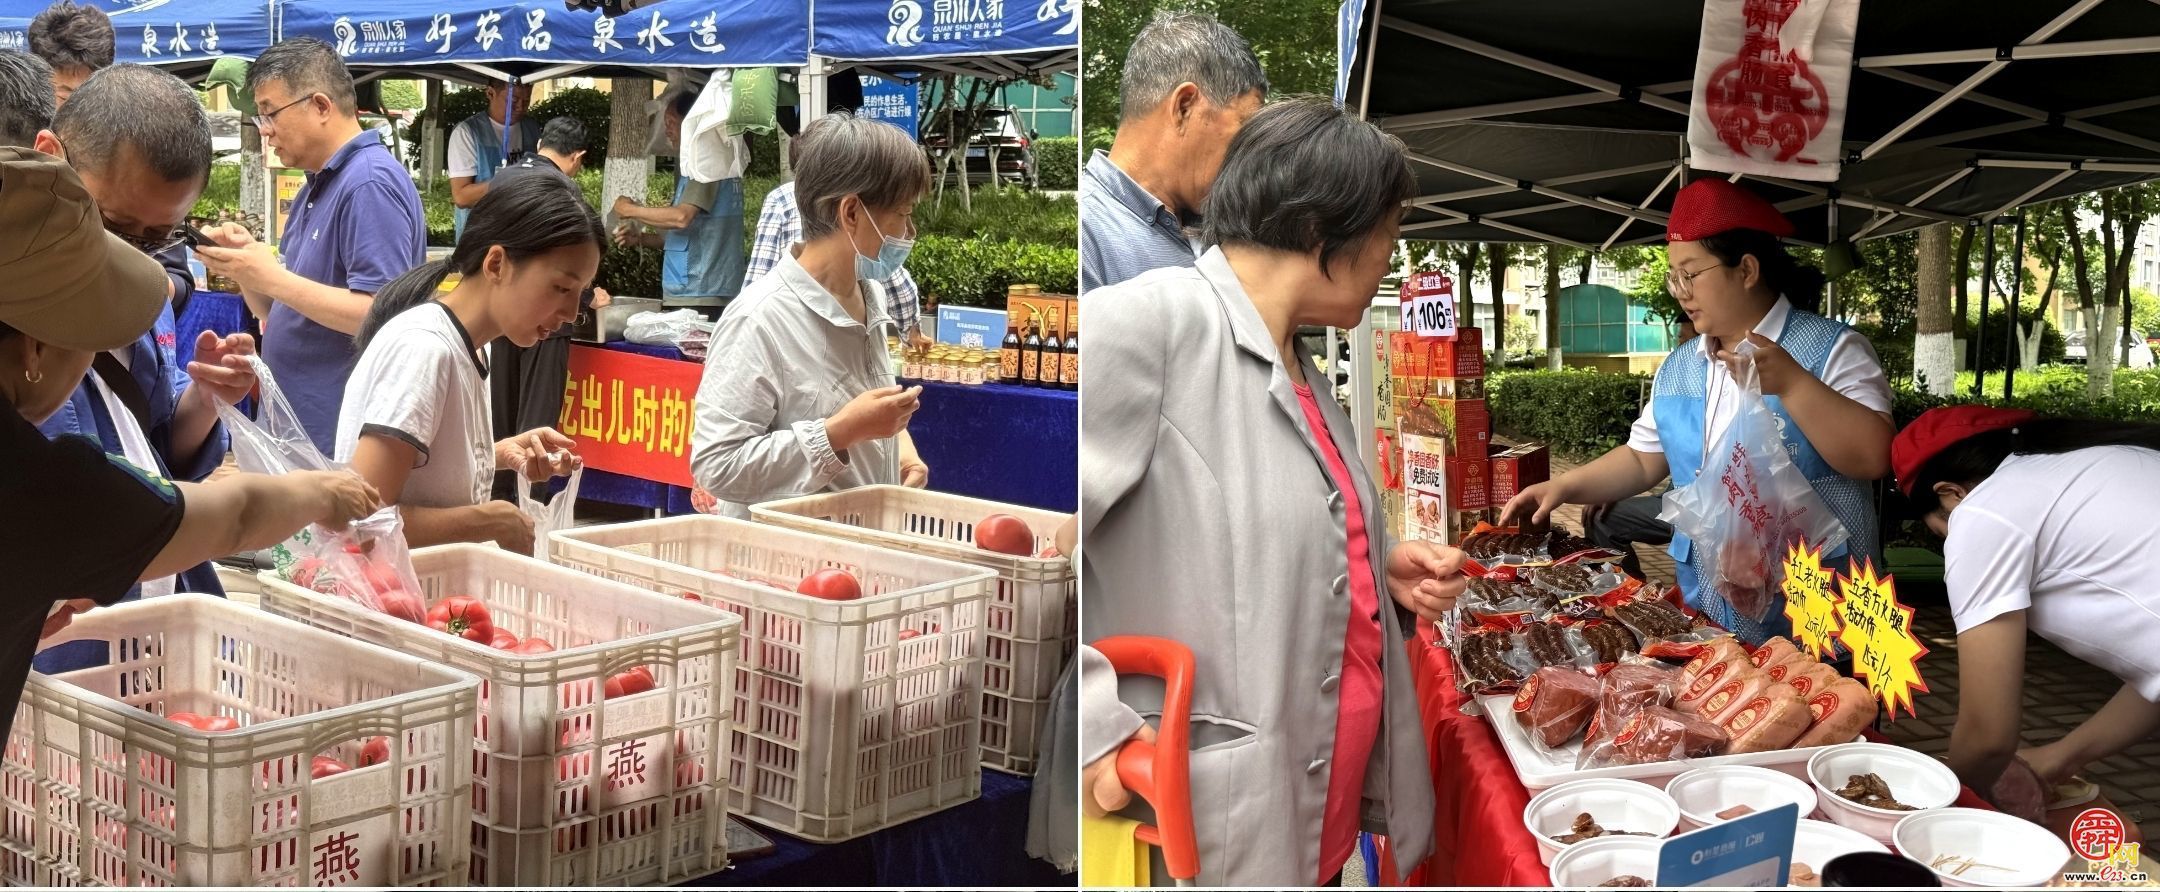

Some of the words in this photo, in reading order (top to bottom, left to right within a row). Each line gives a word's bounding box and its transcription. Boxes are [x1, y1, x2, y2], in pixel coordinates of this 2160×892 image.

[1412, 466, 1440, 488] 免费试吃
[1848, 578, 1907, 640] 五香方火腿
[608, 738, 646, 792] 燕
[313, 830, 360, 887] 燕
